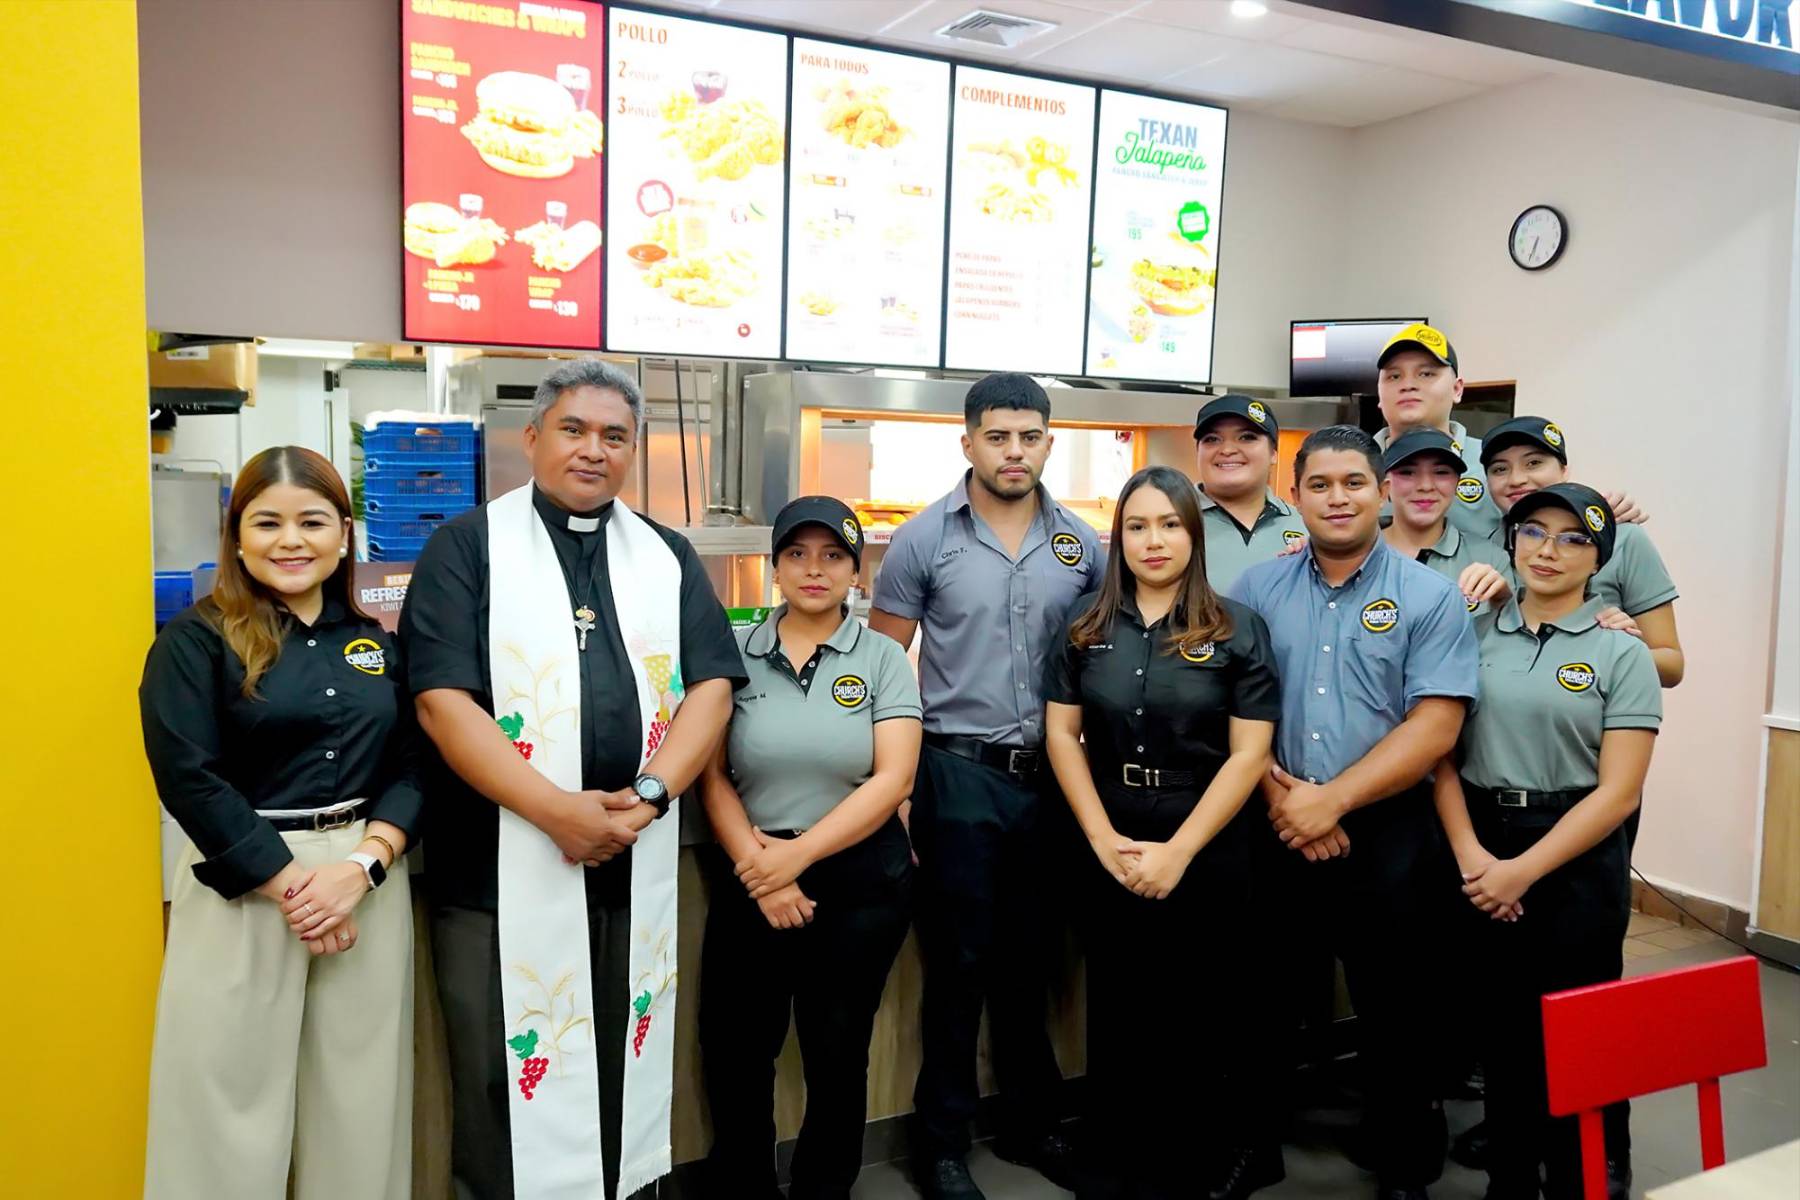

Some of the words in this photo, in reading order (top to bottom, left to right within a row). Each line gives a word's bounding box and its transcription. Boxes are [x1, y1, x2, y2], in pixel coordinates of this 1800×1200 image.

[618, 22, 667, 44] POLLO
[618, 60, 626, 78] 2
[801, 53, 831, 68] PARA
[834, 58, 869, 75] TODOS
[617, 96, 626, 114] 3
[961, 85, 1066, 115] COMPLEMENTOS
[1138, 118, 1197, 149] TEXAN
[1115, 131, 1207, 174] Jalapeño
[1363, 608, 1399, 621] CHURCH'S
[345, 649, 384, 665] CHURCH'S
[1559, 669, 1594, 683] CHURCH'S
[834, 684, 866, 696] CHURCH'S
